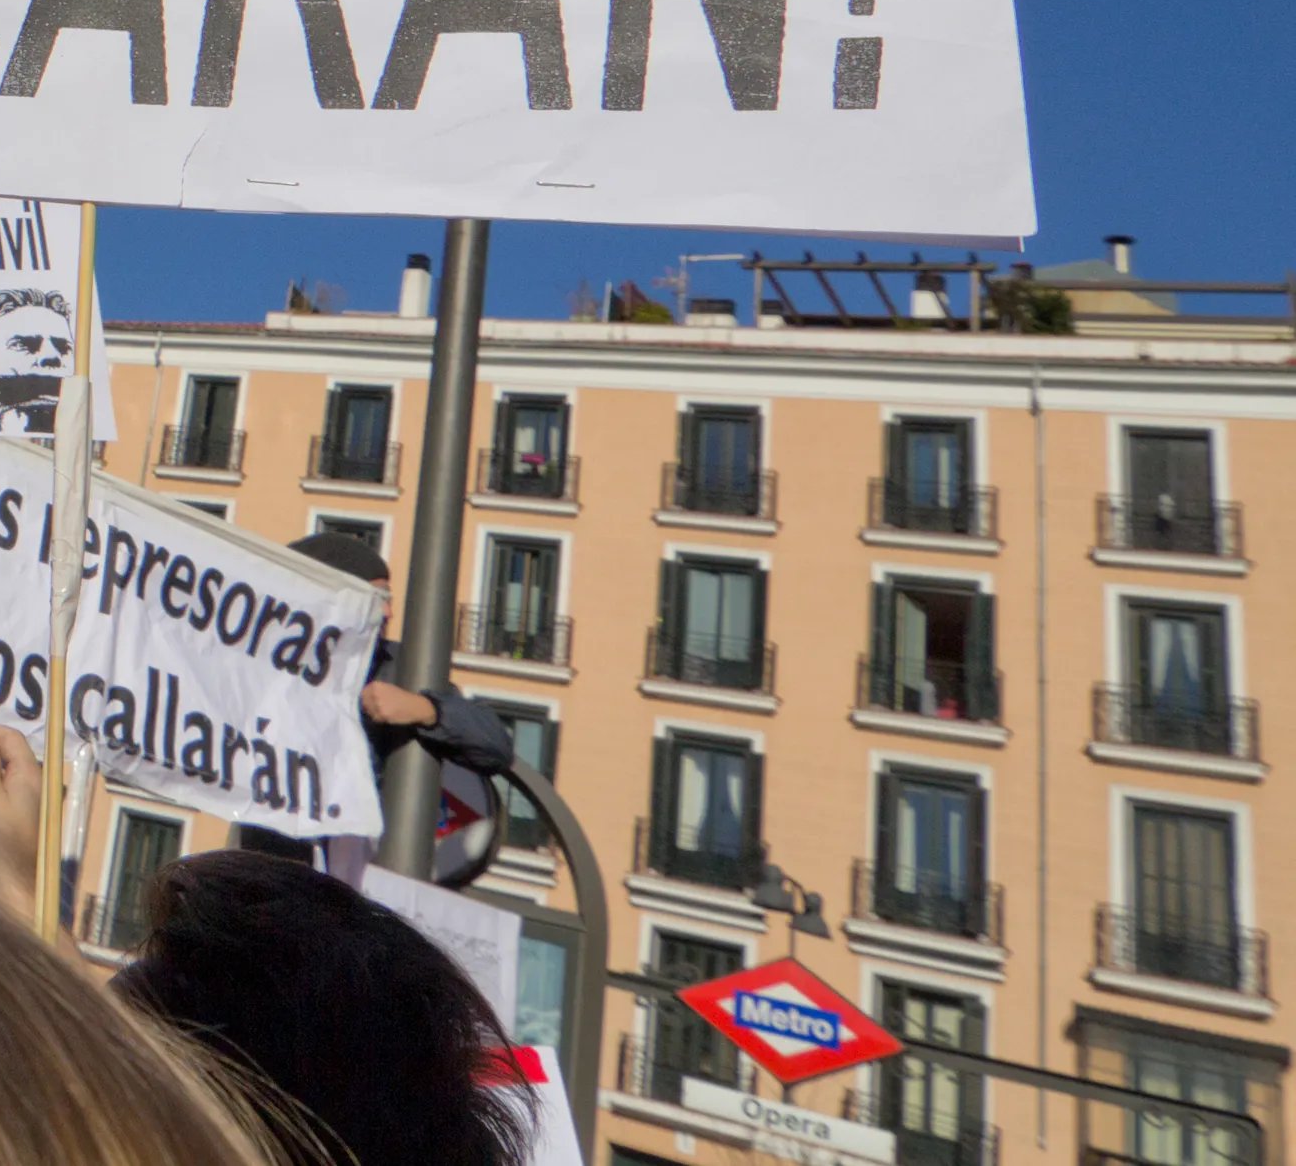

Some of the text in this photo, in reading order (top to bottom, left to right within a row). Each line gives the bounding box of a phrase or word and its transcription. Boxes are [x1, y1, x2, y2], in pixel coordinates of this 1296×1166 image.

[69, 666, 342, 823] callarán.
[740, 994, 836, 1042] Metro
[740, 1096, 832, 1140] Opera
